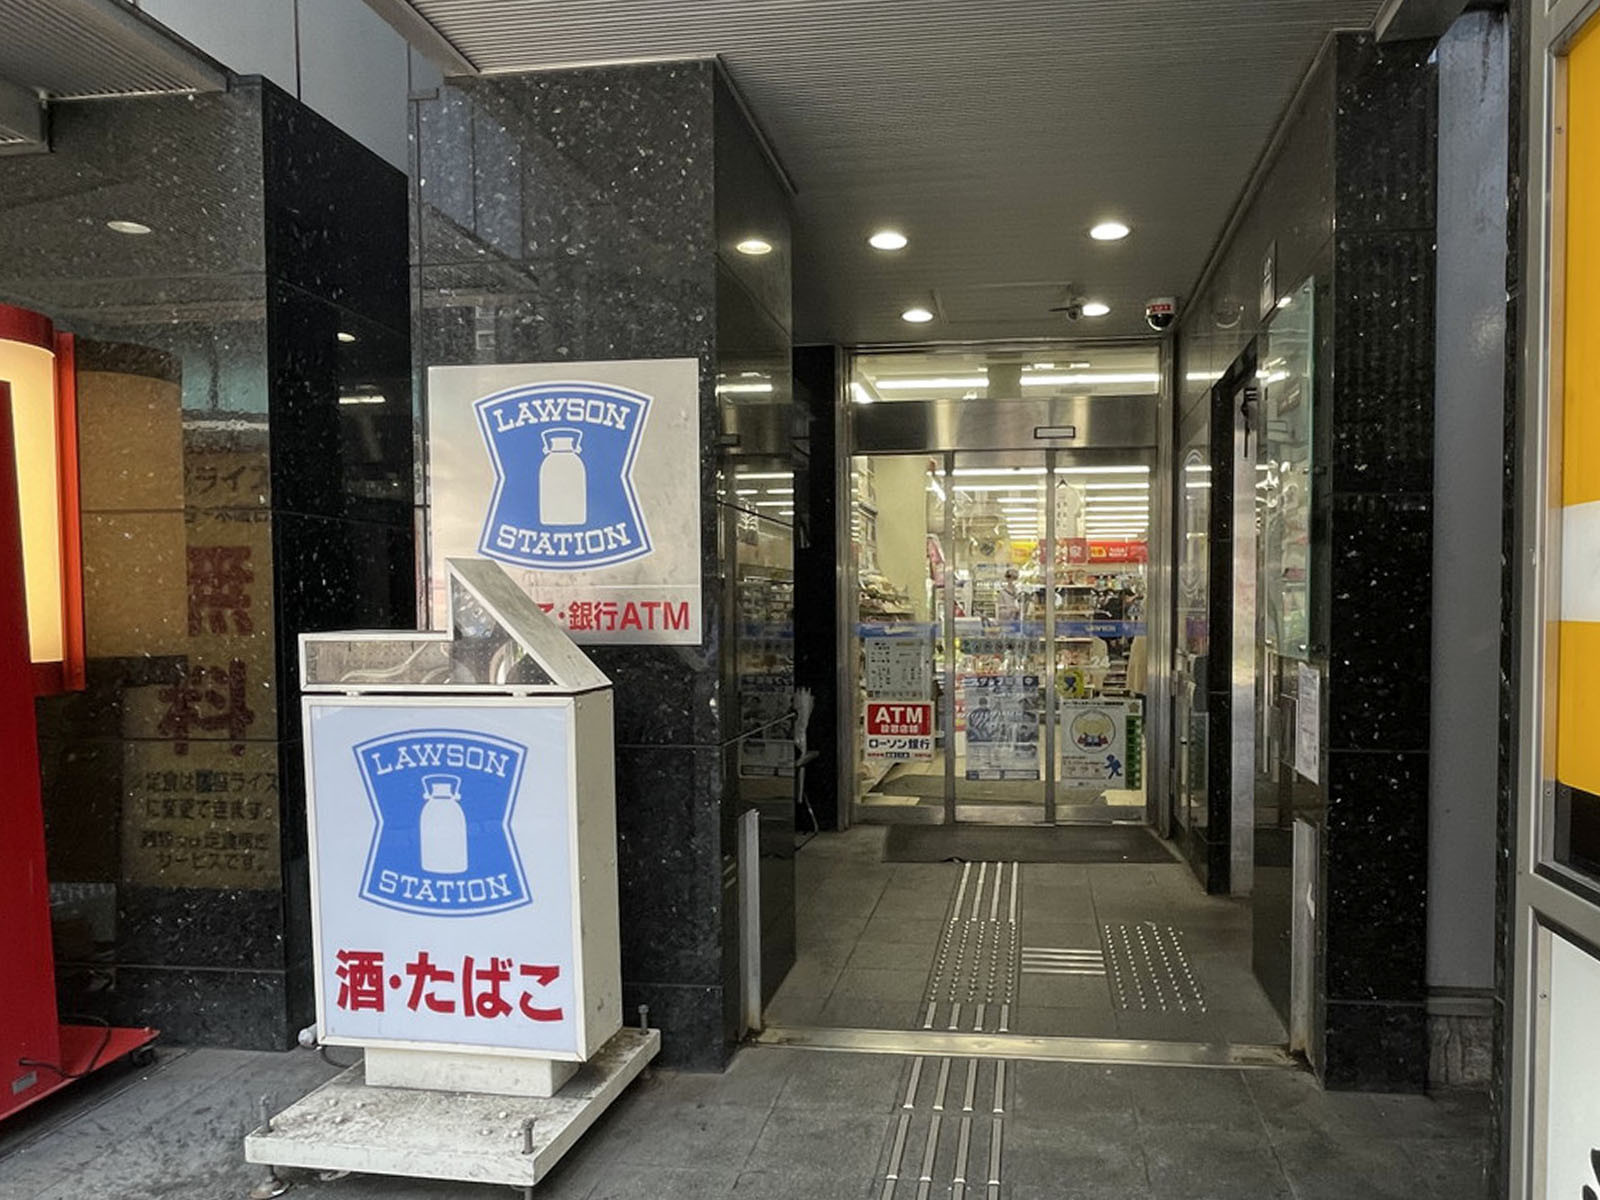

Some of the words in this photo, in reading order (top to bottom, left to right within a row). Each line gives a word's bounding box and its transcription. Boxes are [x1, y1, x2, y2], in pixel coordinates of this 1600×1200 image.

[493, 398, 630, 432] LAWSON
[496, 523, 630, 555] STATION
[875, 706, 923, 724] ATM
[371, 743, 510, 777] LAWSON
[868, 738, 930, 750] ローソン銀行
[379, 869, 512, 903] STATION
